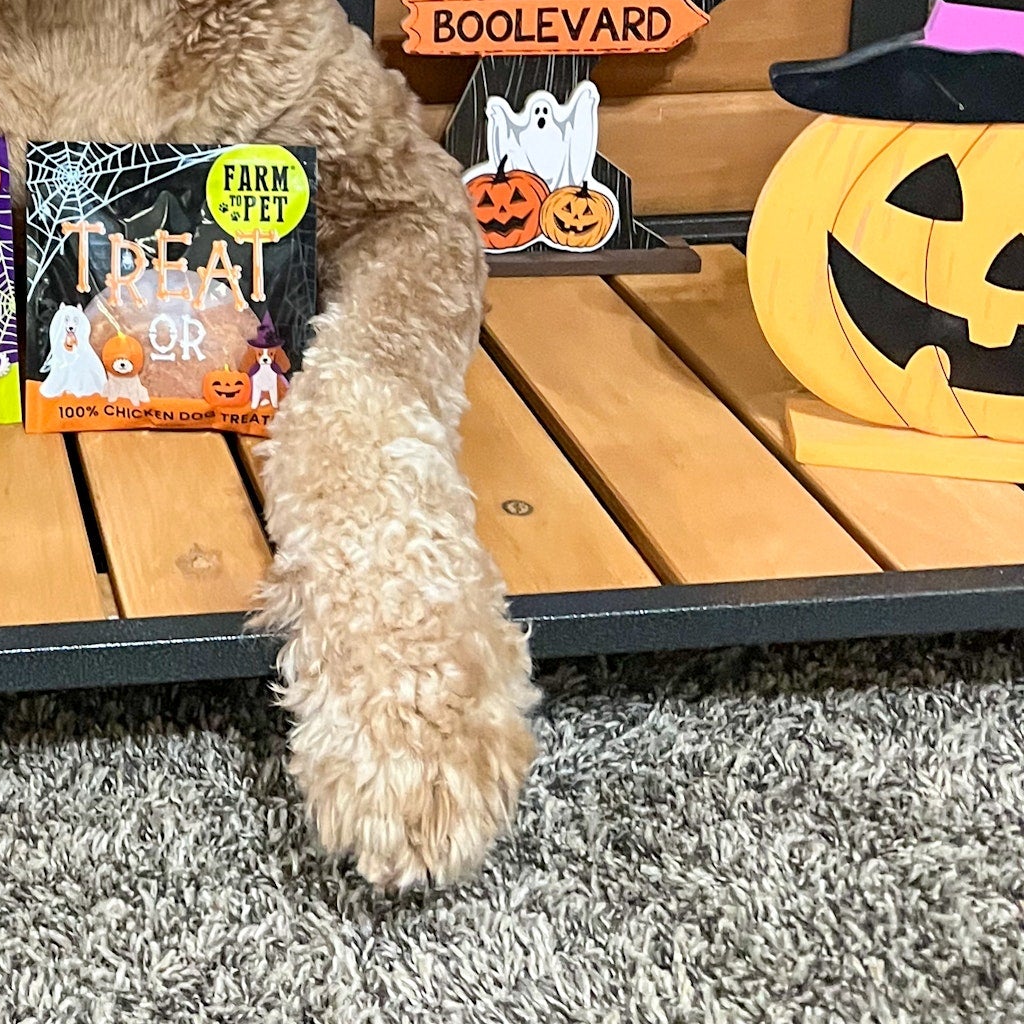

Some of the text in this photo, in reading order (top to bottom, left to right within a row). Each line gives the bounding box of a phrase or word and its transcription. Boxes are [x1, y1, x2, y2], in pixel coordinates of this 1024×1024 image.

[433, 6, 672, 44] BOOLEVARD
[223, 164, 290, 193] FARM
[229, 194, 288, 223] TO PET
[61, 220, 280, 312] TREAT
[148, 313, 206, 361] OR
[58, 405, 99, 419] 100%
[103, 404, 175, 421] CHICKEN
[221, 412, 274, 426] TREAT
